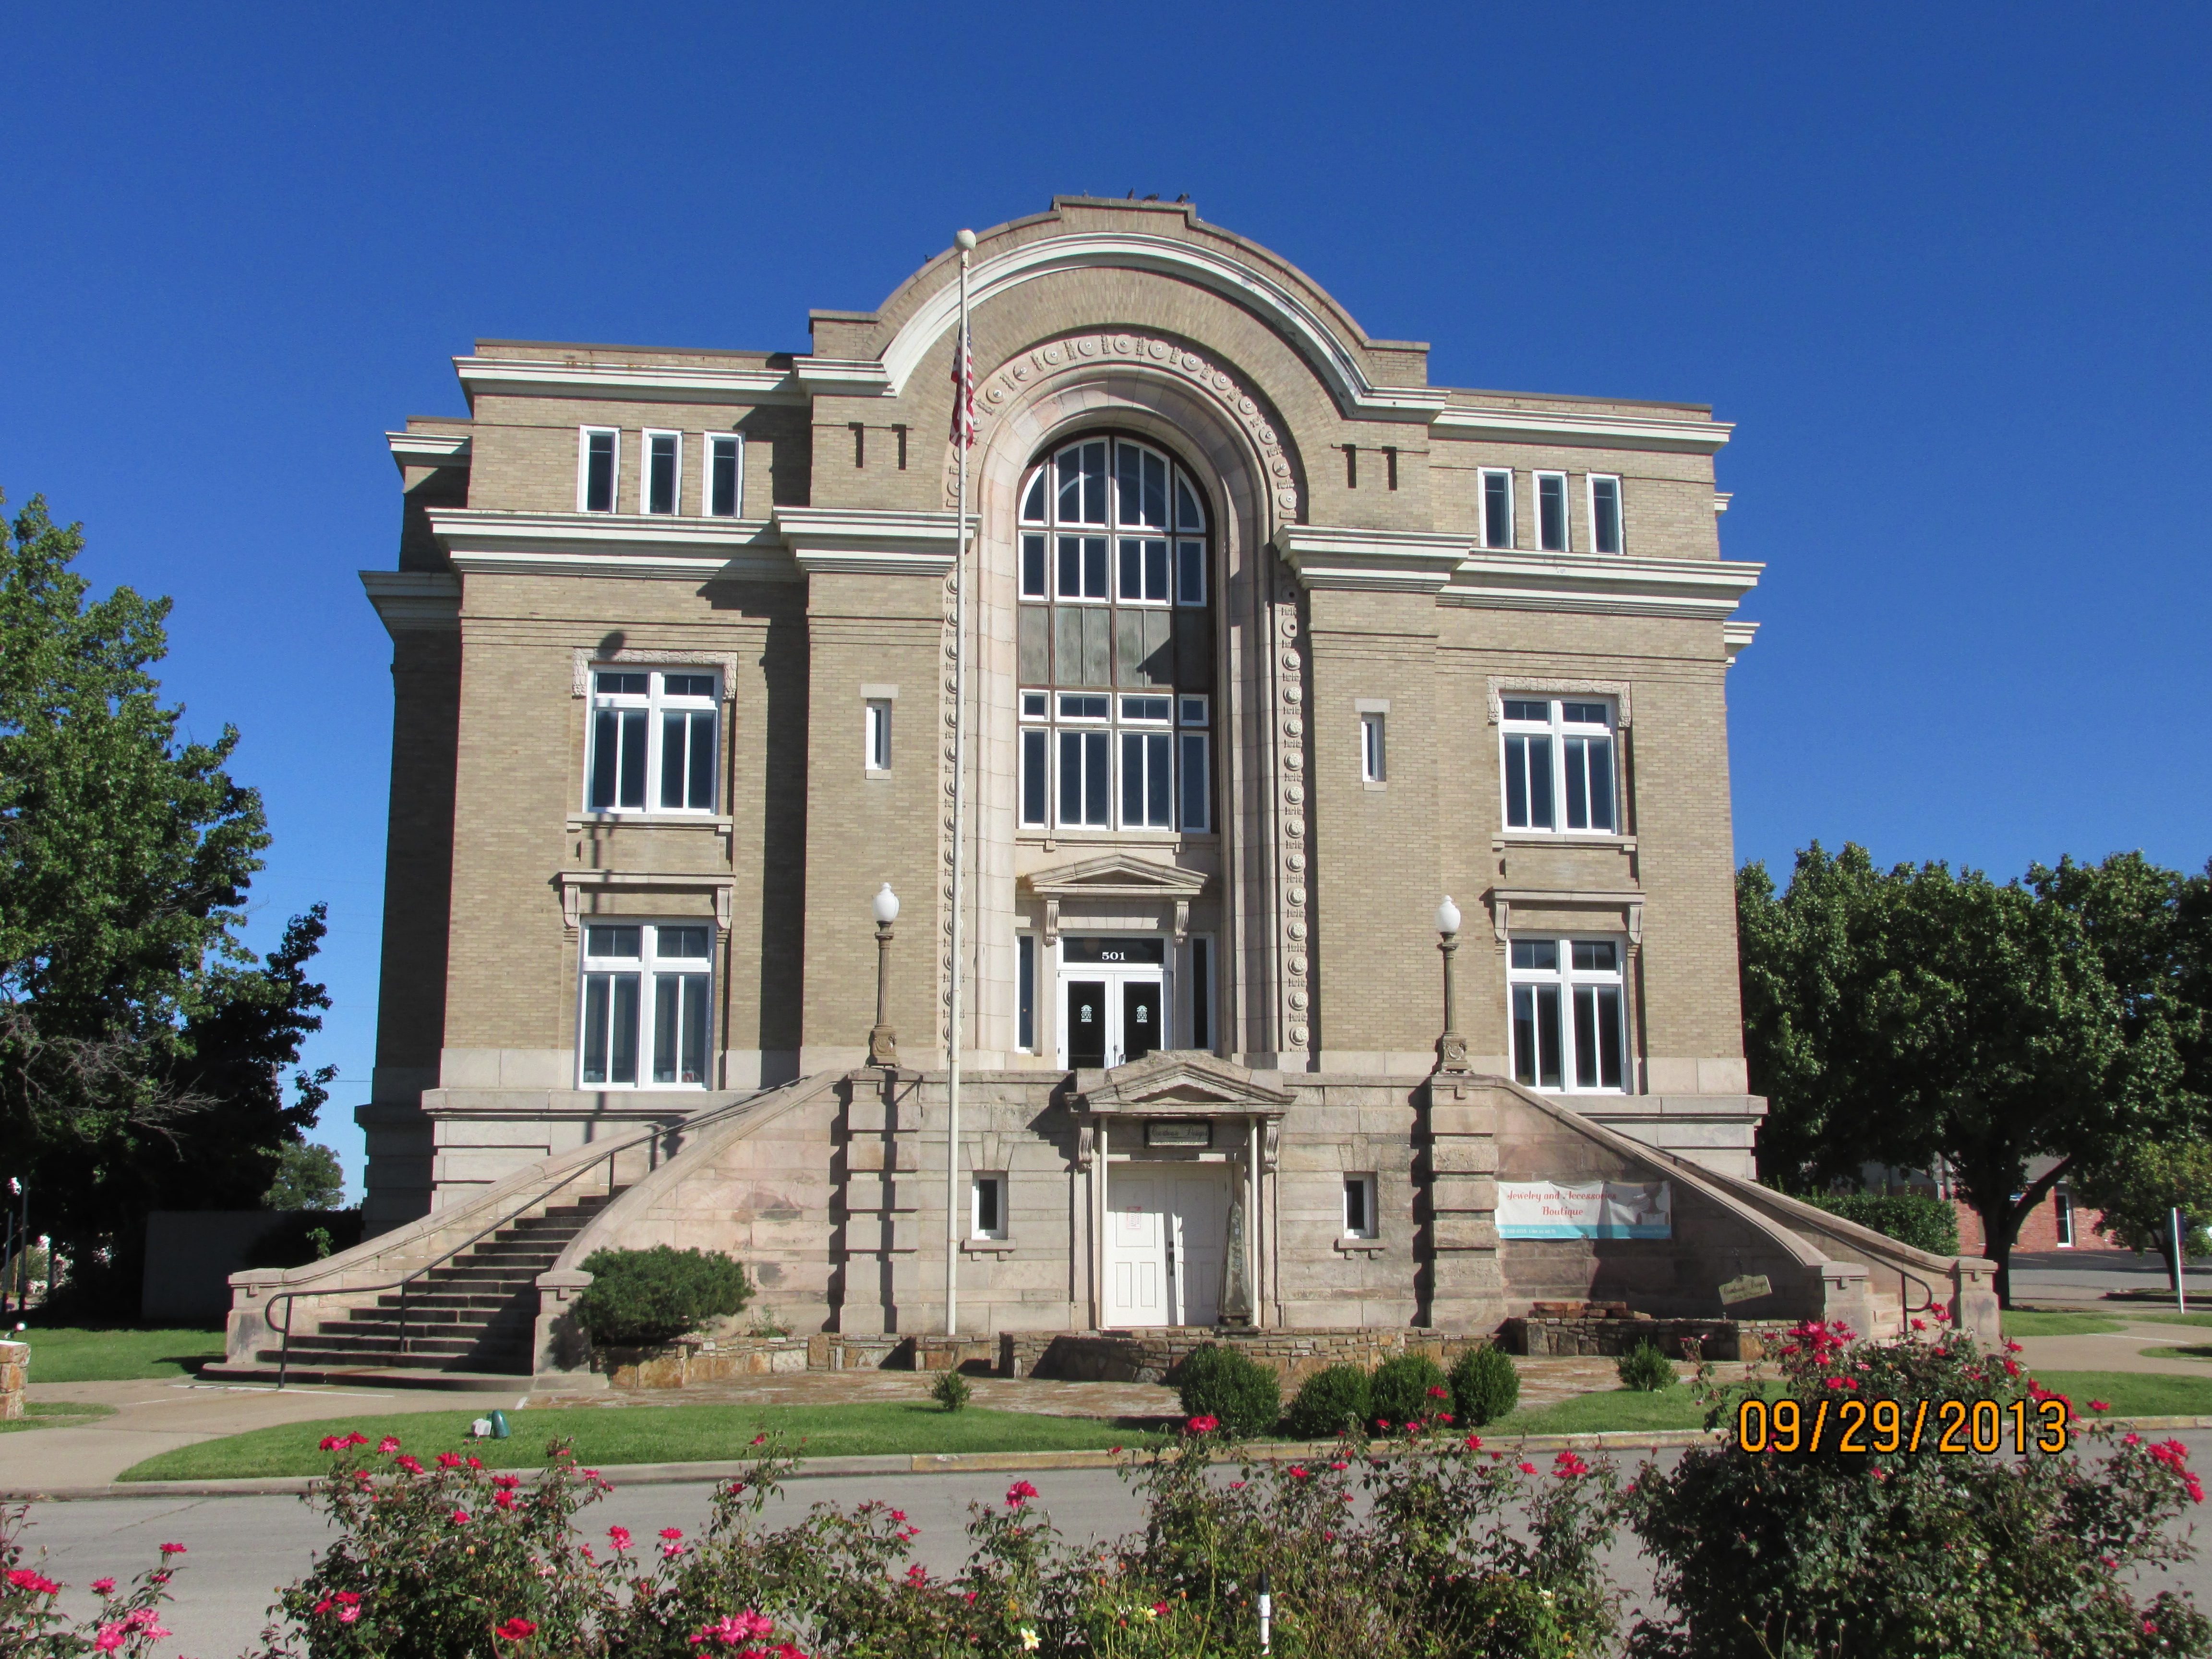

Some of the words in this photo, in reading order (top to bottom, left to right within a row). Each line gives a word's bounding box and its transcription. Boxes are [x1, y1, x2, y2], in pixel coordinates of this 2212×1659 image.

[1102, 951, 1125, 960] 501
[1507, 1190, 1541, 1202] Jewelry
[1544, 1190, 1560, 1200] and
[1562, 1190, 1617, 1200] Accessories
[1541, 1206, 1583, 1218] Boutique
